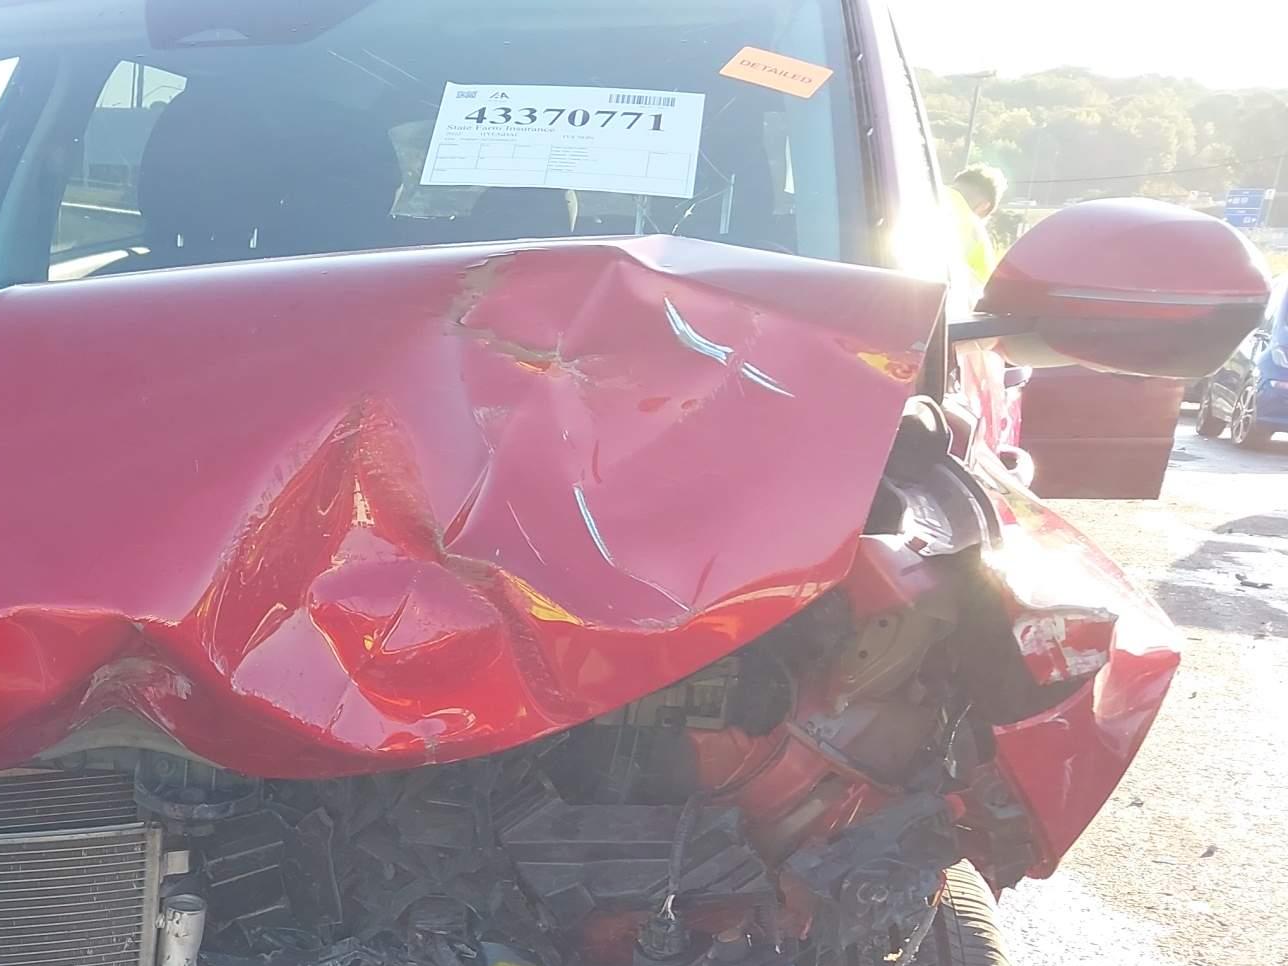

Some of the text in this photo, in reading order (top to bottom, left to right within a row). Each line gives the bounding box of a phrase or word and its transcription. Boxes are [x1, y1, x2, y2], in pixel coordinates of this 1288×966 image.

[740, 59, 813, 84] DETAILED
[464, 106, 664, 132] 43370771
[475, 124, 502, 132] Farm
[505, 125, 556, 133] Insurance
